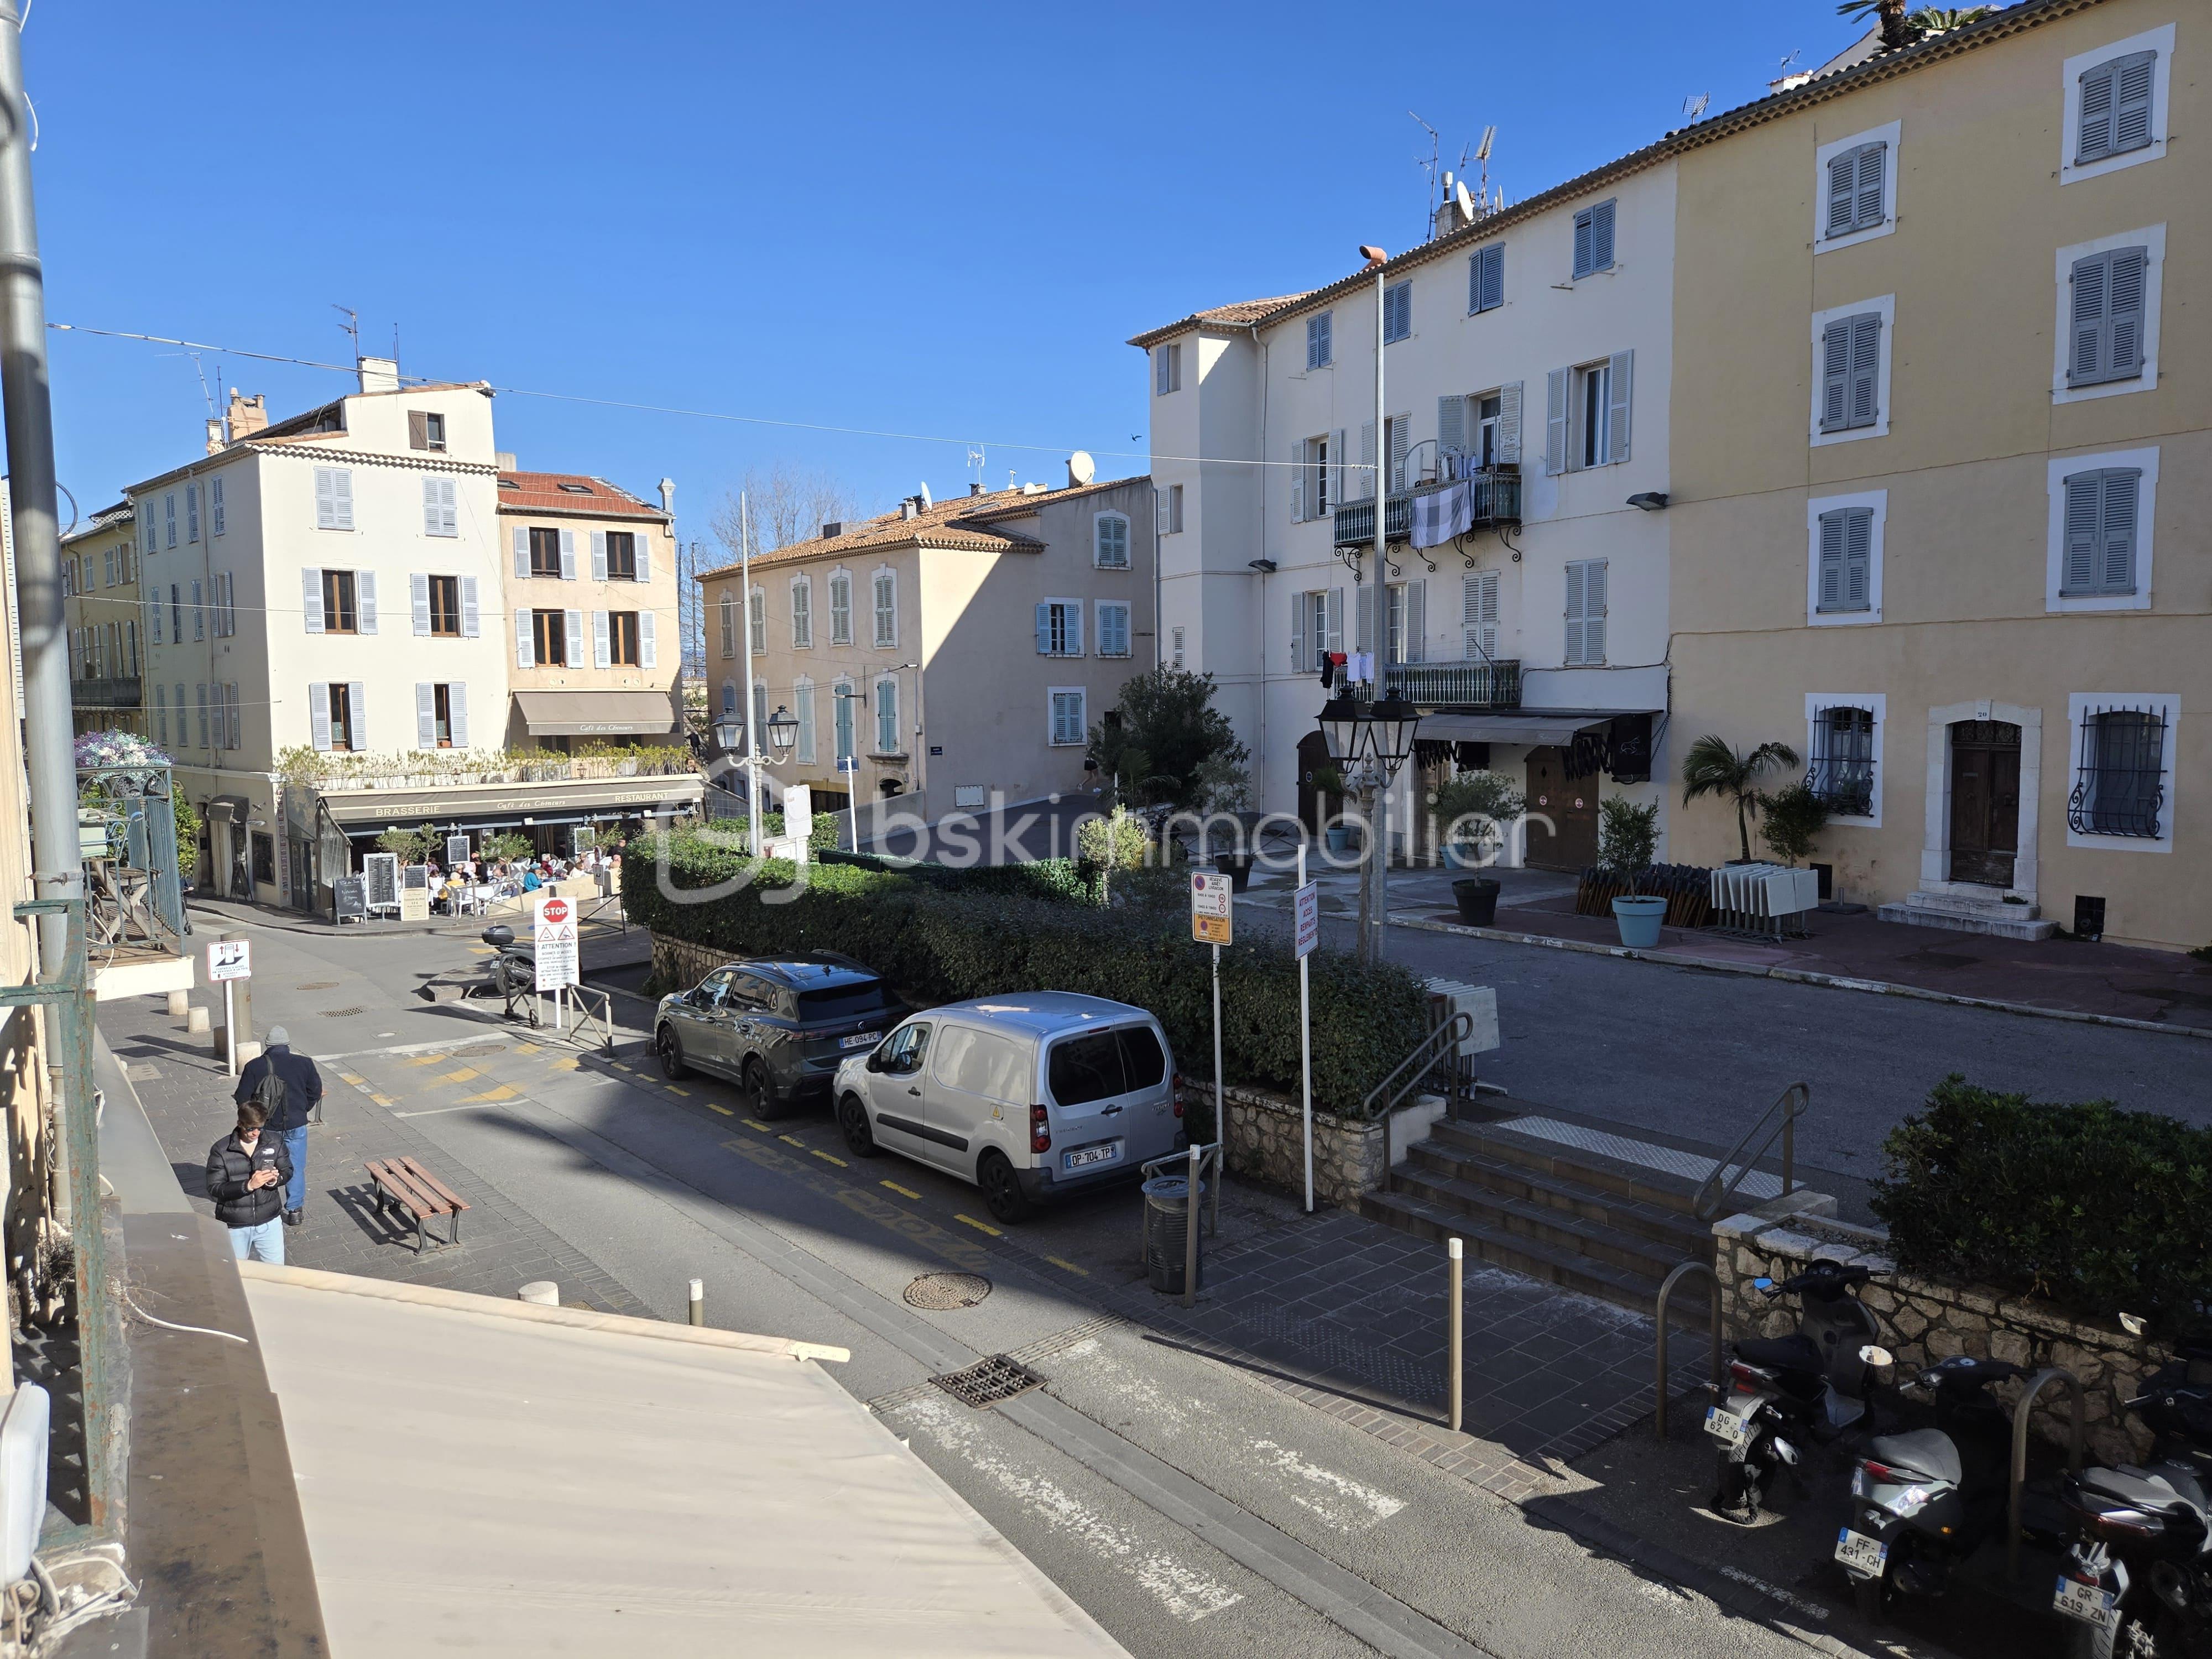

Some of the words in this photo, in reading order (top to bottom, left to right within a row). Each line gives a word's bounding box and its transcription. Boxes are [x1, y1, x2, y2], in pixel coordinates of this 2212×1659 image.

[615, 792, 669, 802] RESTAURANT
[376, 806, 441, 817] BRASSERIE
[1299, 891, 1316, 907] ATTENTION
[544, 907, 567, 916] STOP
[1301, 916, 1316, 932] REMPARTS
